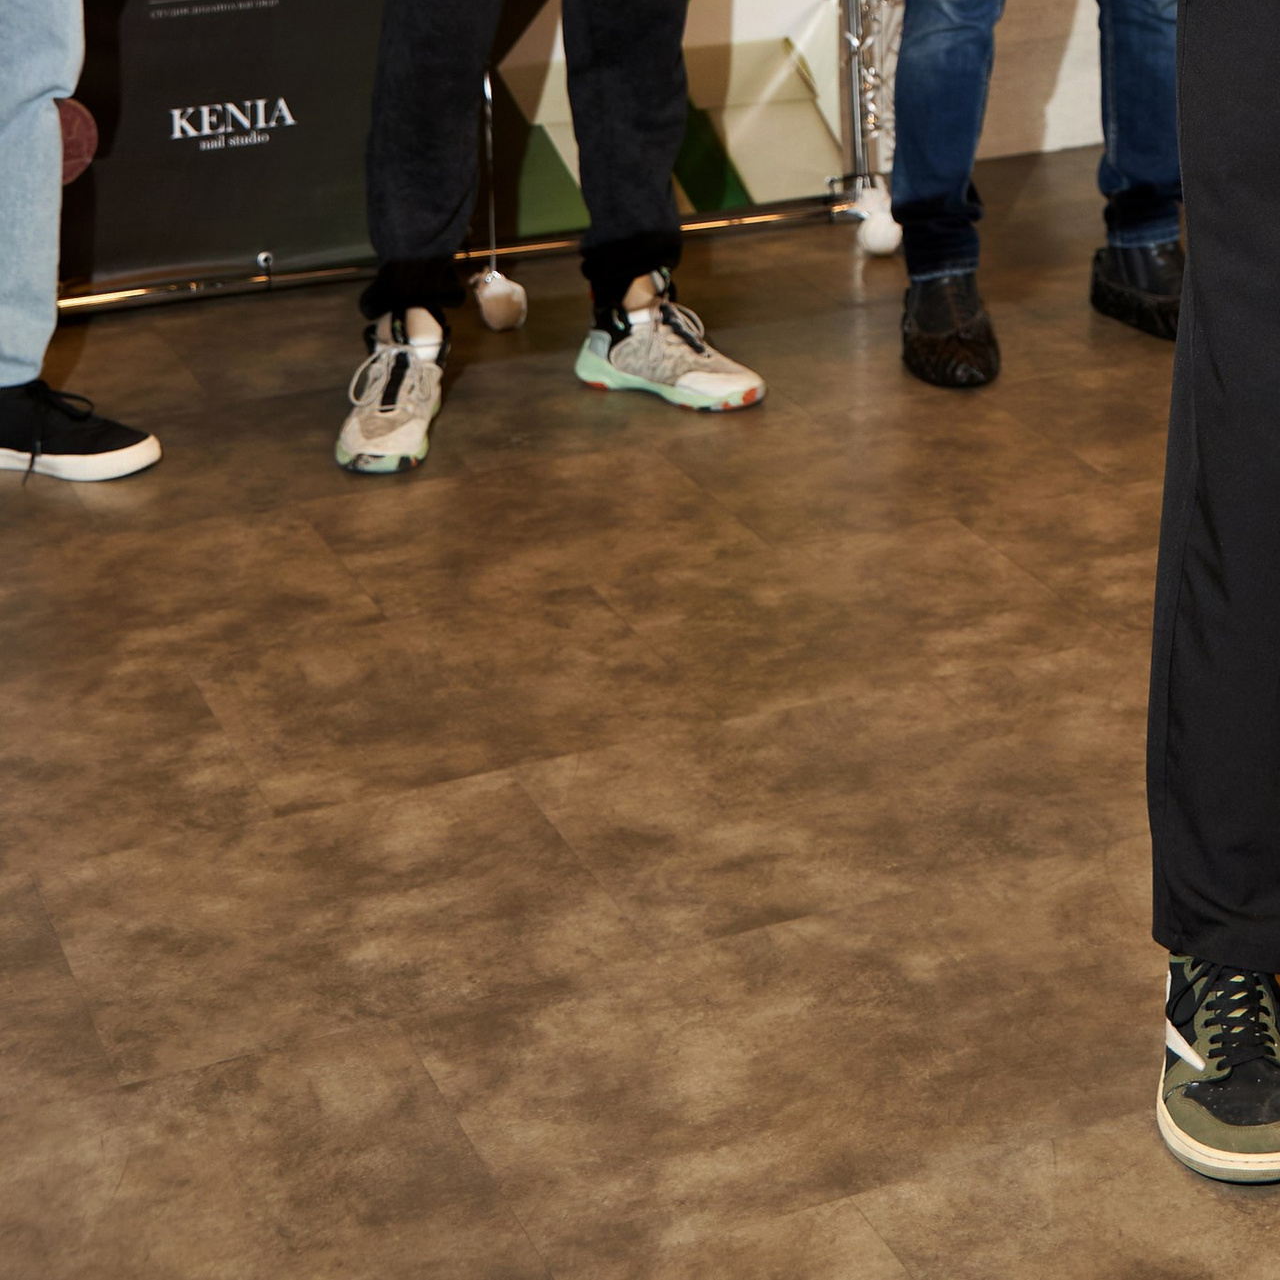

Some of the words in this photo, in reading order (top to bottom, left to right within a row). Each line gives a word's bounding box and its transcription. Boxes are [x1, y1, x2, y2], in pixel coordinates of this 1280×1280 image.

[169, 96, 298, 141] KENIA
[199, 134, 226, 152] nail
[227, 129, 270, 147] studio
